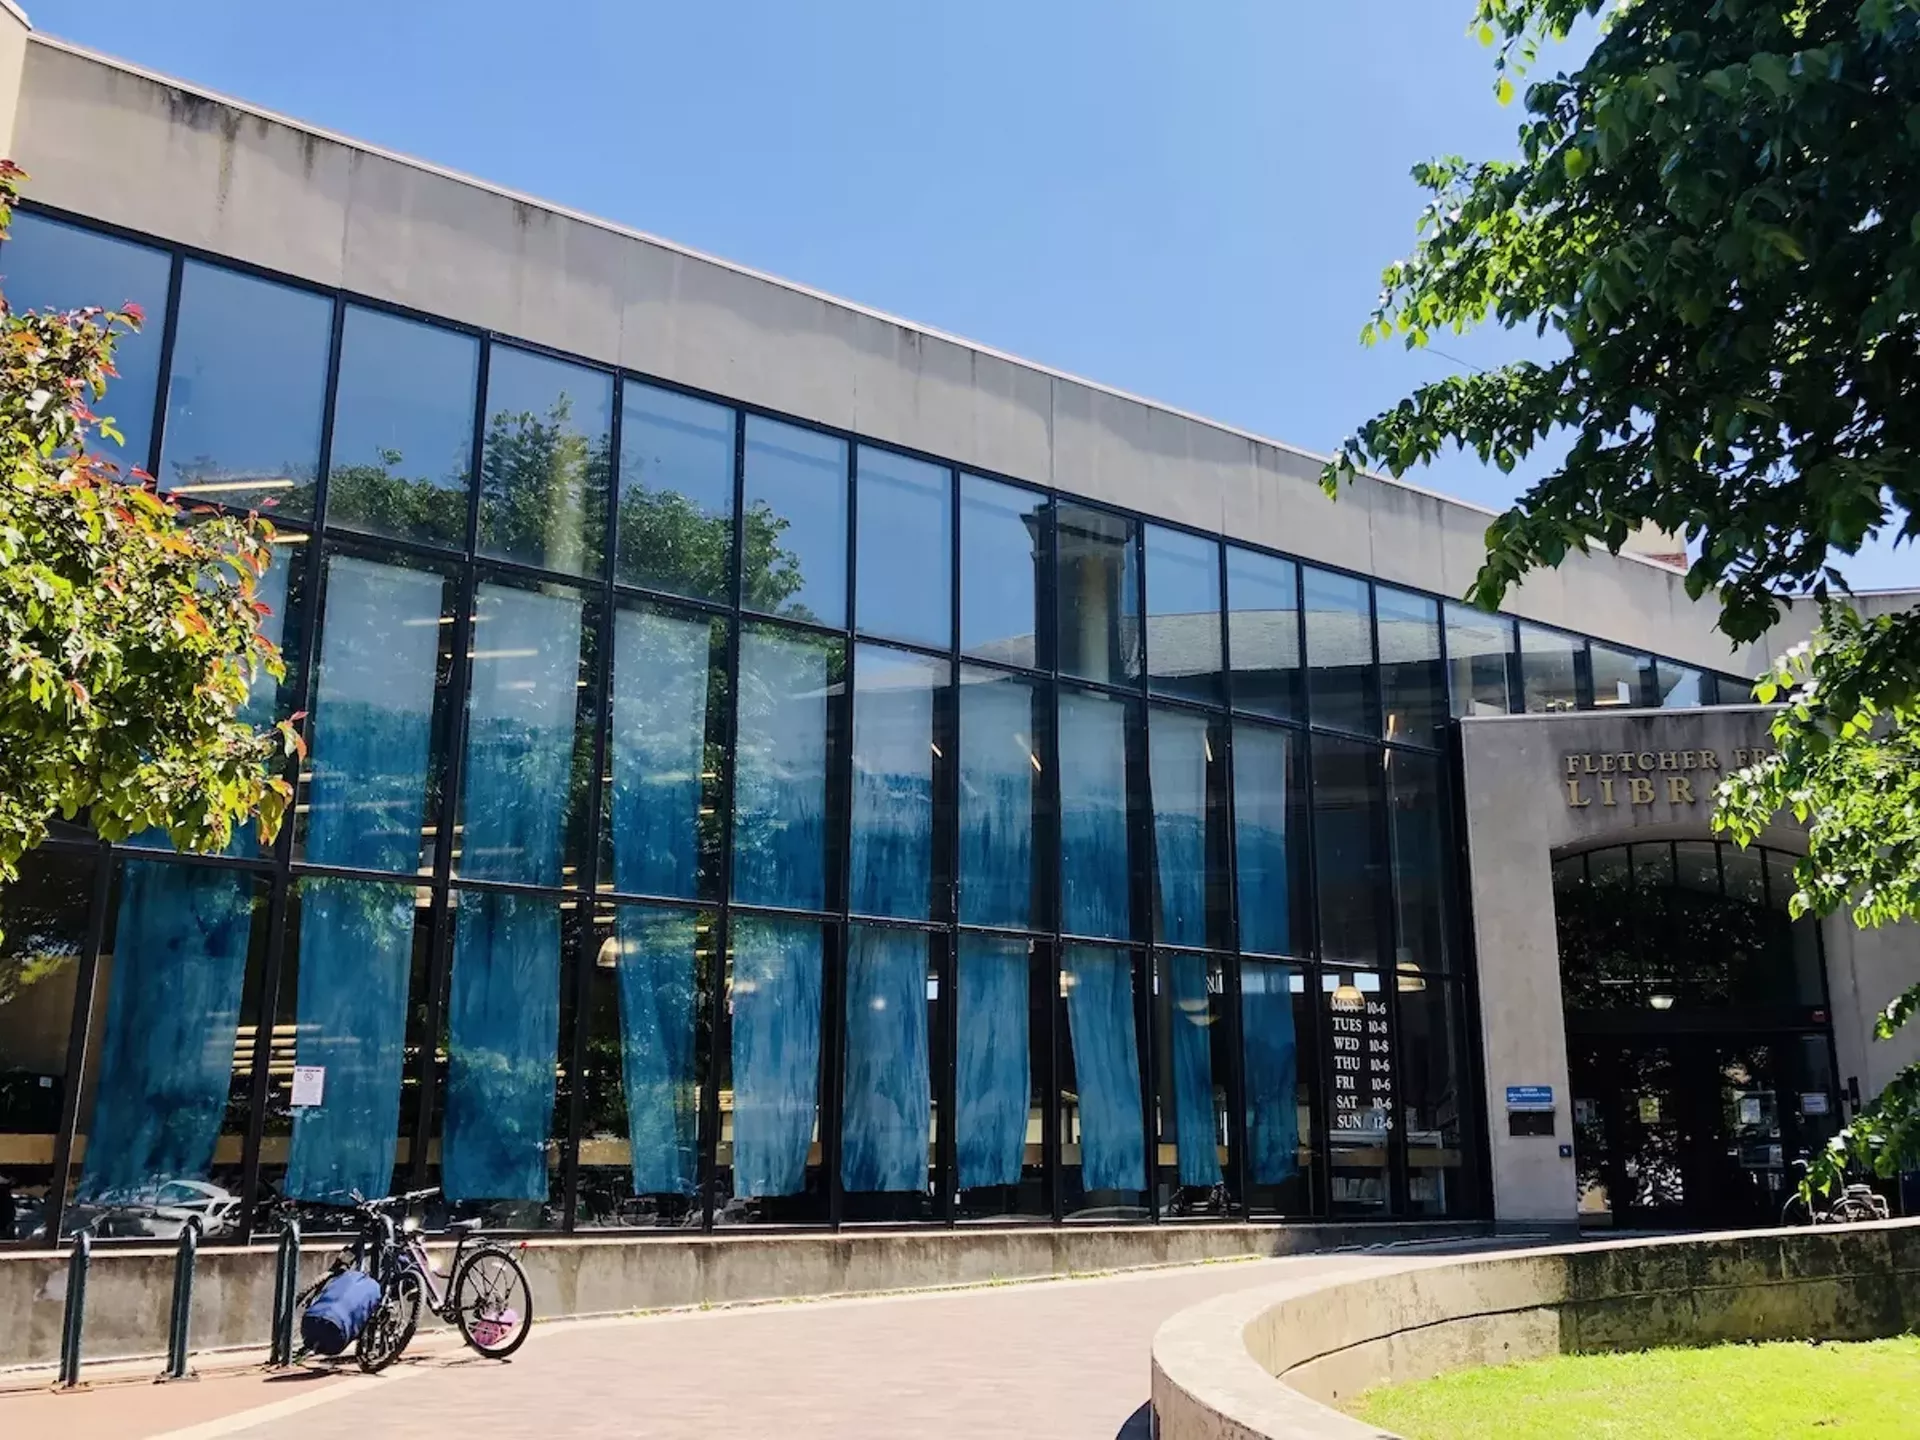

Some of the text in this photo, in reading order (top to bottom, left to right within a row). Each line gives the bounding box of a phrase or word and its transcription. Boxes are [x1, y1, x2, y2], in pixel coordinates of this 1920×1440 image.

[1566, 747, 1779, 774] FLETCHER FR
[1367, 1001, 1387, 1015] 10-6
[1332, 1016, 1362, 1032] TUES
[1333, 1036, 1360, 1051] WED
[1334, 1056, 1391, 1072] THU 10-6
[1335, 1075, 1391, 1091] FRI 10-6
[1336, 1095, 1393, 1110] SAT 10-6
[1337, 1114, 1362, 1129] SUN
